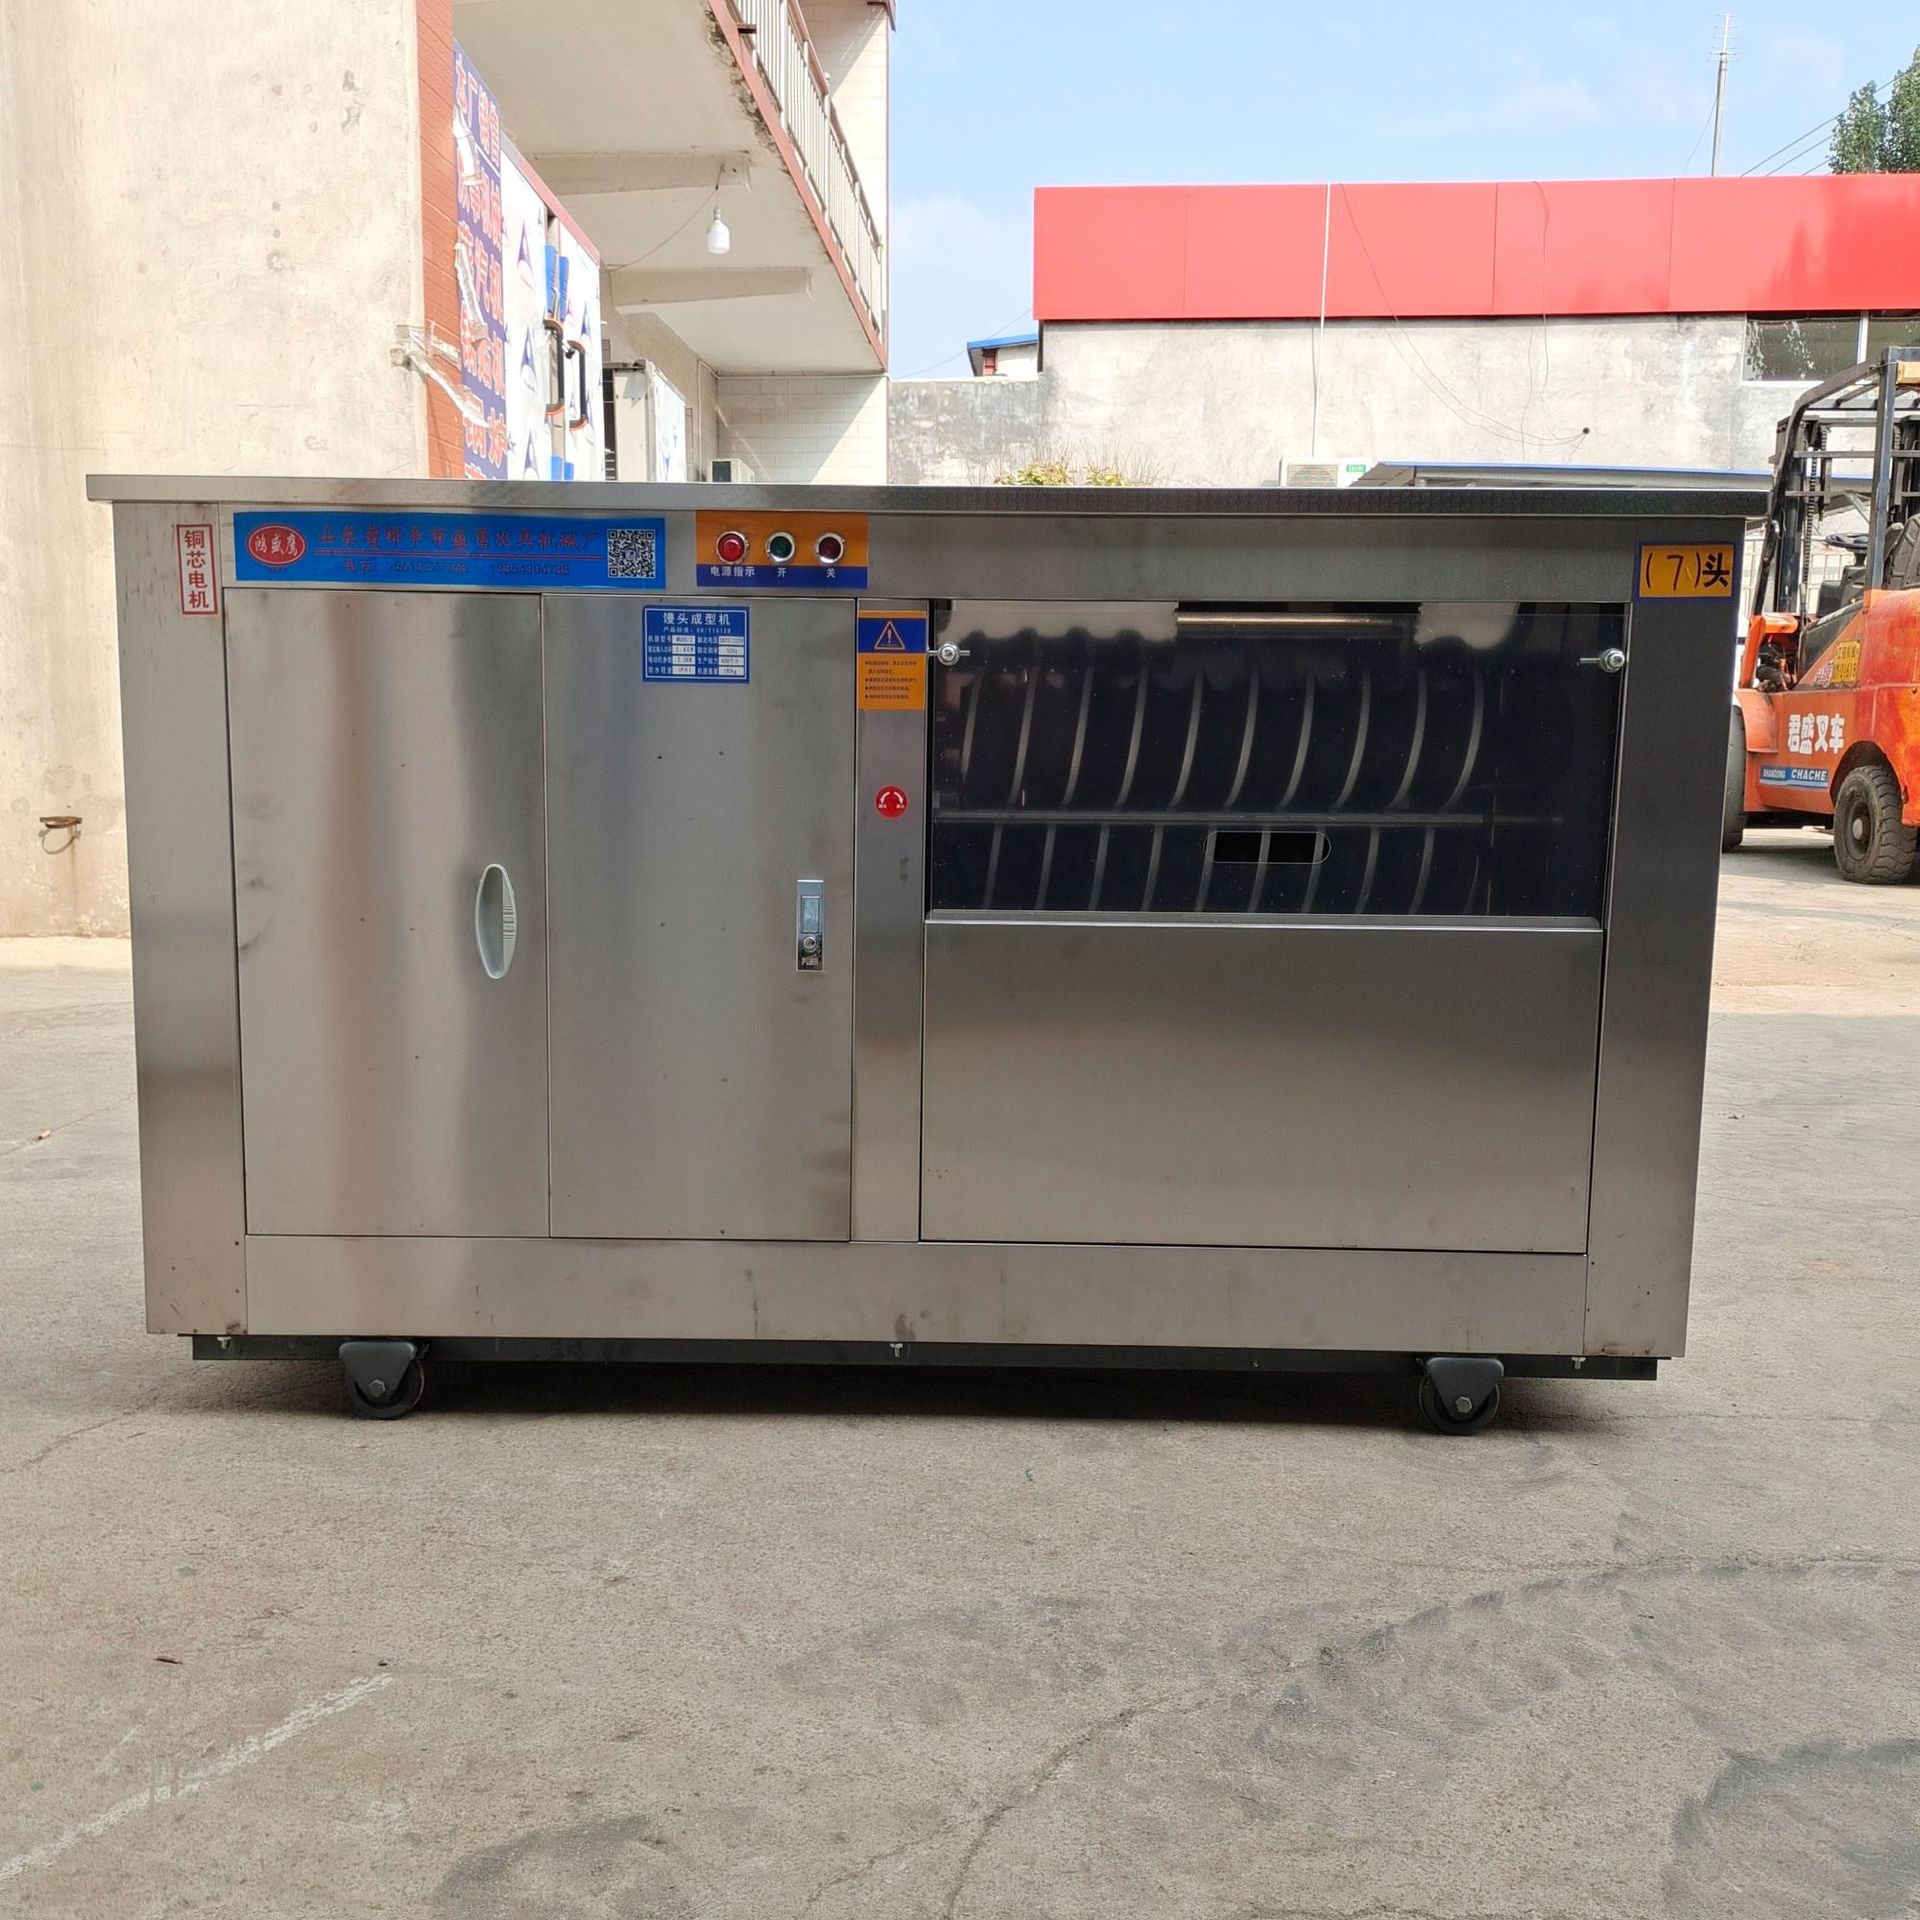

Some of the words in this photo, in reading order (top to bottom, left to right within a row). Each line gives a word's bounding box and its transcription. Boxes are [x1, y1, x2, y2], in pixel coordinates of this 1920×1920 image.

[184, 529, 210, 609] 铜芯电机
[710, 566, 756, 577] 电源指示
[777, 567, 788, 578] 开
[825, 568, 836, 578] 关
[663, 612, 730, 625] 馒头成型机
[1788, 713, 1845, 755] 君盛叉车
[1791, 768, 1827, 781] CHACHE
